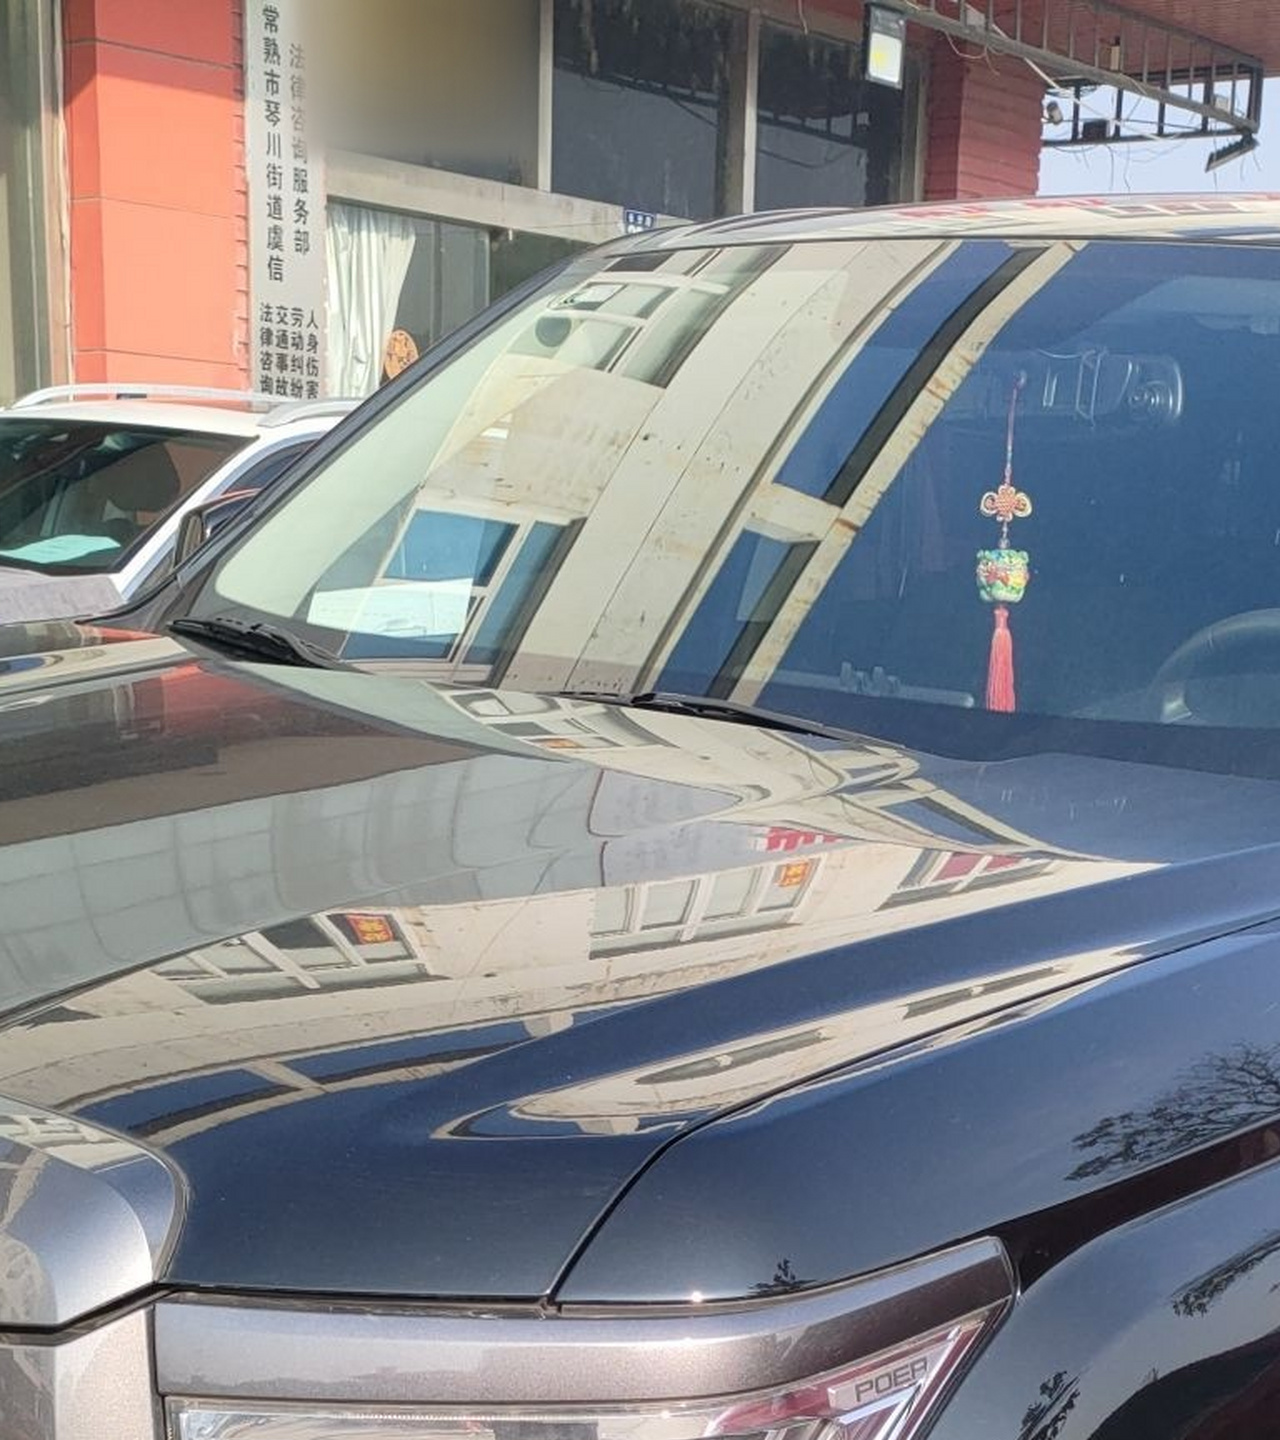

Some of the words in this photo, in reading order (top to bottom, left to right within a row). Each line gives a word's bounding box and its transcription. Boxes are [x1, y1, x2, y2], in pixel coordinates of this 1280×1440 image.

[262, 4, 285, 283] 常熟市琴川街道虞信
[289, 42, 310, 256] 法律咨询服务部
[259, 302, 274, 395] 法律咨询
[275, 304, 289, 397] 交通事故
[290, 306, 304, 399] 劳动纠纷
[306, 308, 320, 400] 人身伤害
